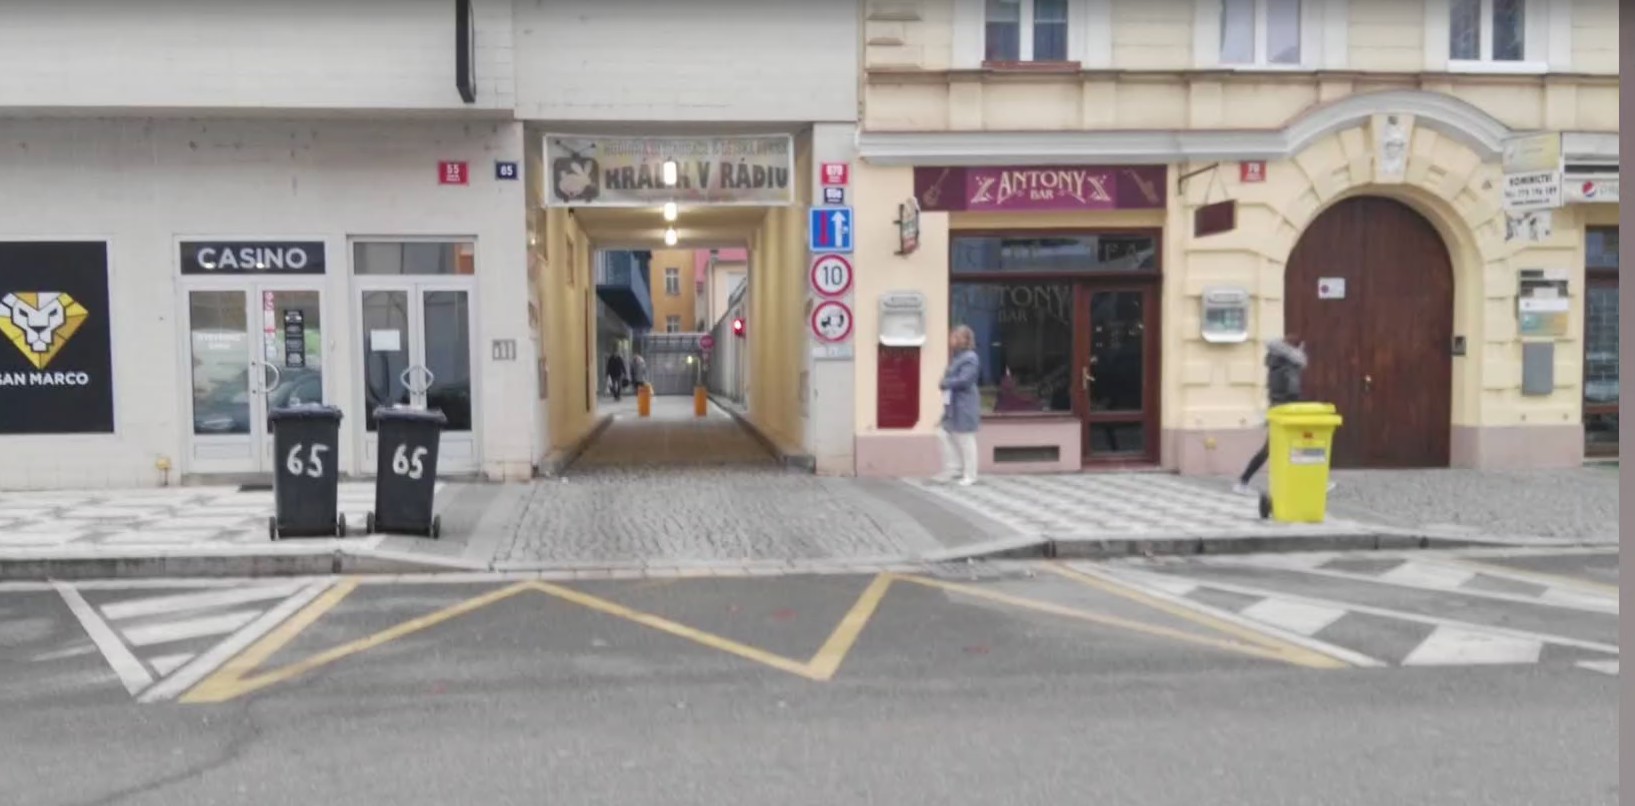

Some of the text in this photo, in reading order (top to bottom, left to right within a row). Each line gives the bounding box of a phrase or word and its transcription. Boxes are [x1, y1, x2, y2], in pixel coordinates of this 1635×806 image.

[605, 157, 788, 190] KRÁLK V RÁDIU
[996, 169, 1087, 204] ANTONY
[1029, 189, 1055, 201] BAR
[197, 246, 308, 269] CASINO
[823, 265, 843, 286] 10
[0, 371, 89, 386] AN MARCO
[287, 443, 330, 478] 65
[392, 443, 428, 480] 65
